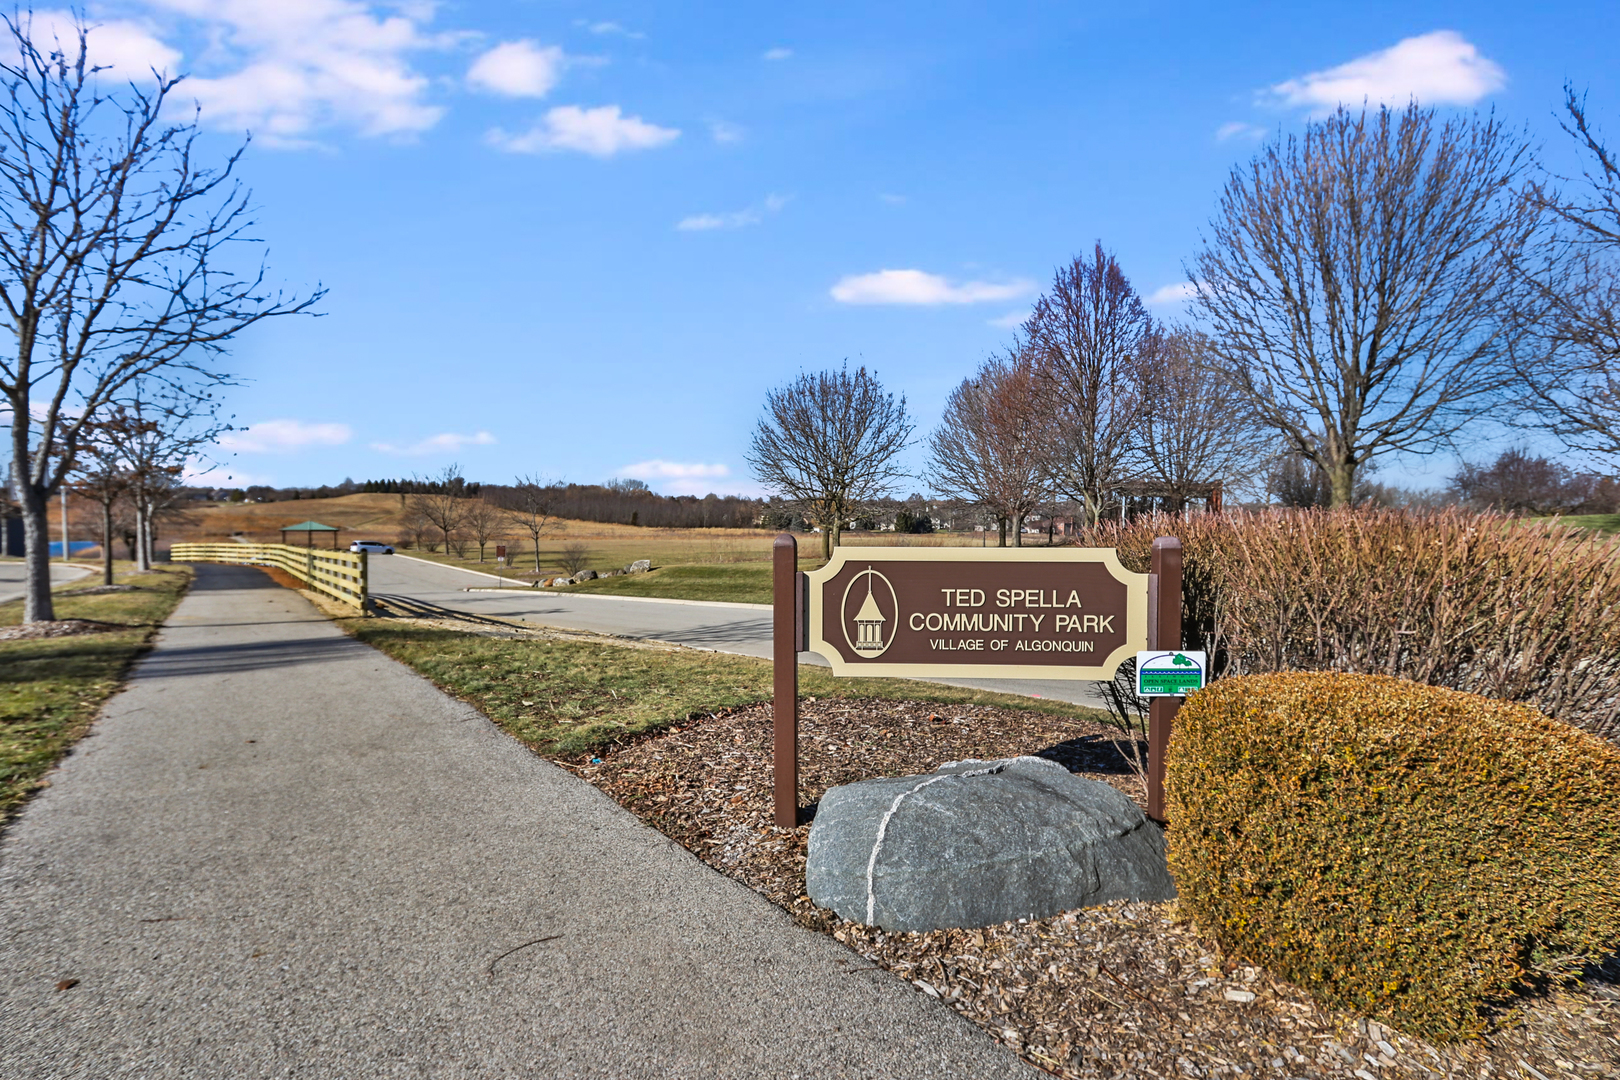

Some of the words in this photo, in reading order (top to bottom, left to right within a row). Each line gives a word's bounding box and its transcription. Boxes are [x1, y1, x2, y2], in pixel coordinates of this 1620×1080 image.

[941, 588, 986, 607] TED
[996, 588, 1082, 608] SPELLA
[909, 612, 1046, 633] COMMUNITY
[1056, 614, 1115, 634] PARK
[929, 638, 985, 651] VILLAGE
[989, 639, 1009, 651] OF
[1014, 639, 1094, 653] ALGONQUIN
